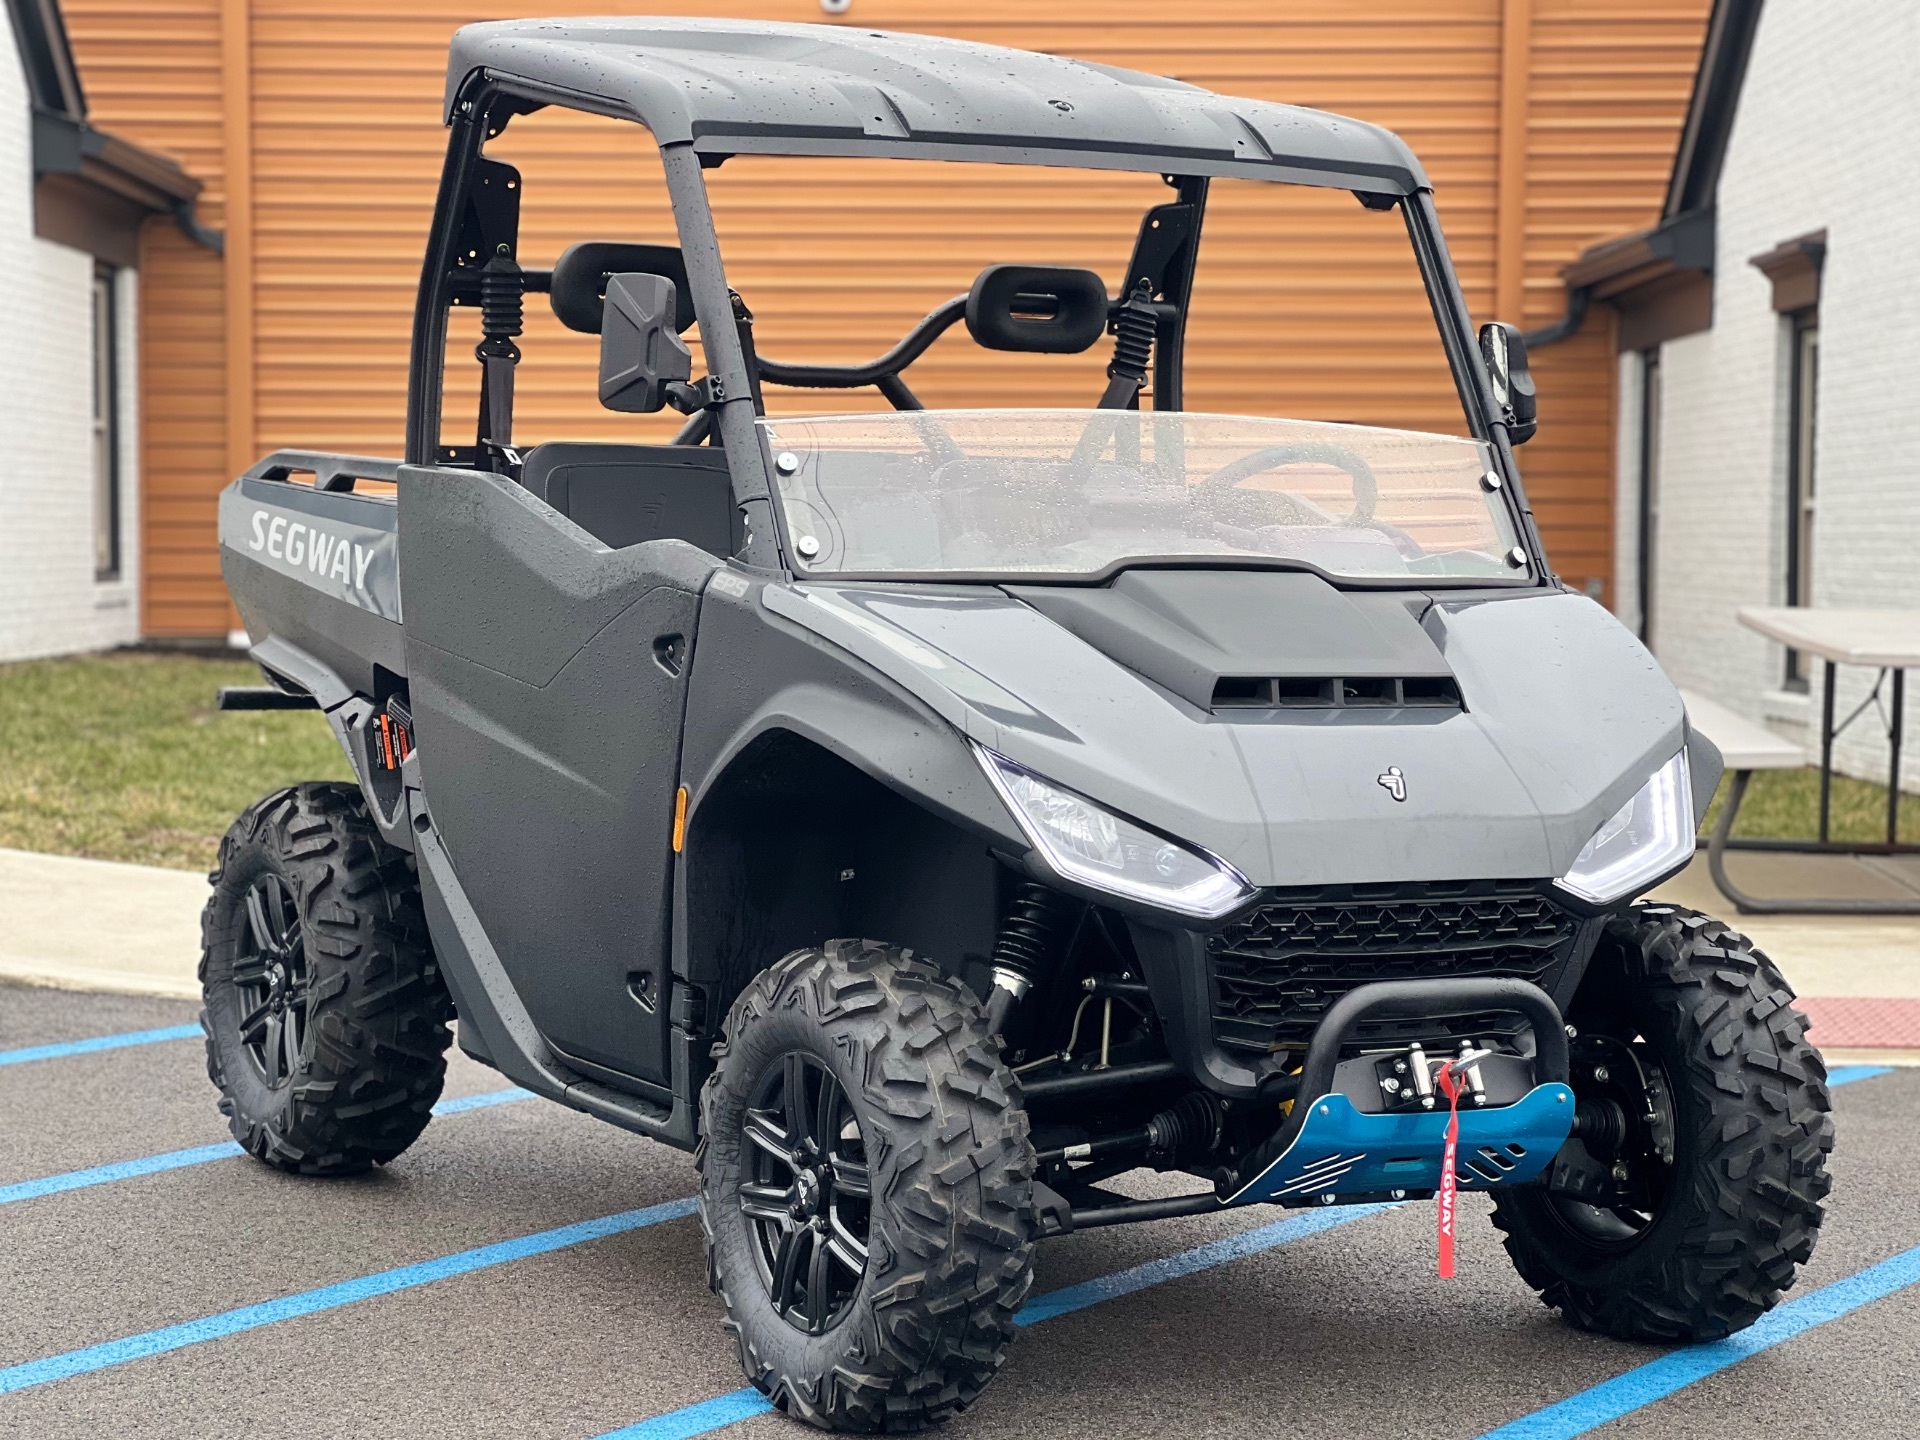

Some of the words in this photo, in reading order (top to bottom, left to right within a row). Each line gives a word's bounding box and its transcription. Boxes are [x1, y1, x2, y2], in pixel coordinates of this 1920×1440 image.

[249, 510, 375, 590] SEGWAY
[711, 572, 749, 598] EPS
[1441, 1142, 1455, 1237] SEGWAY
